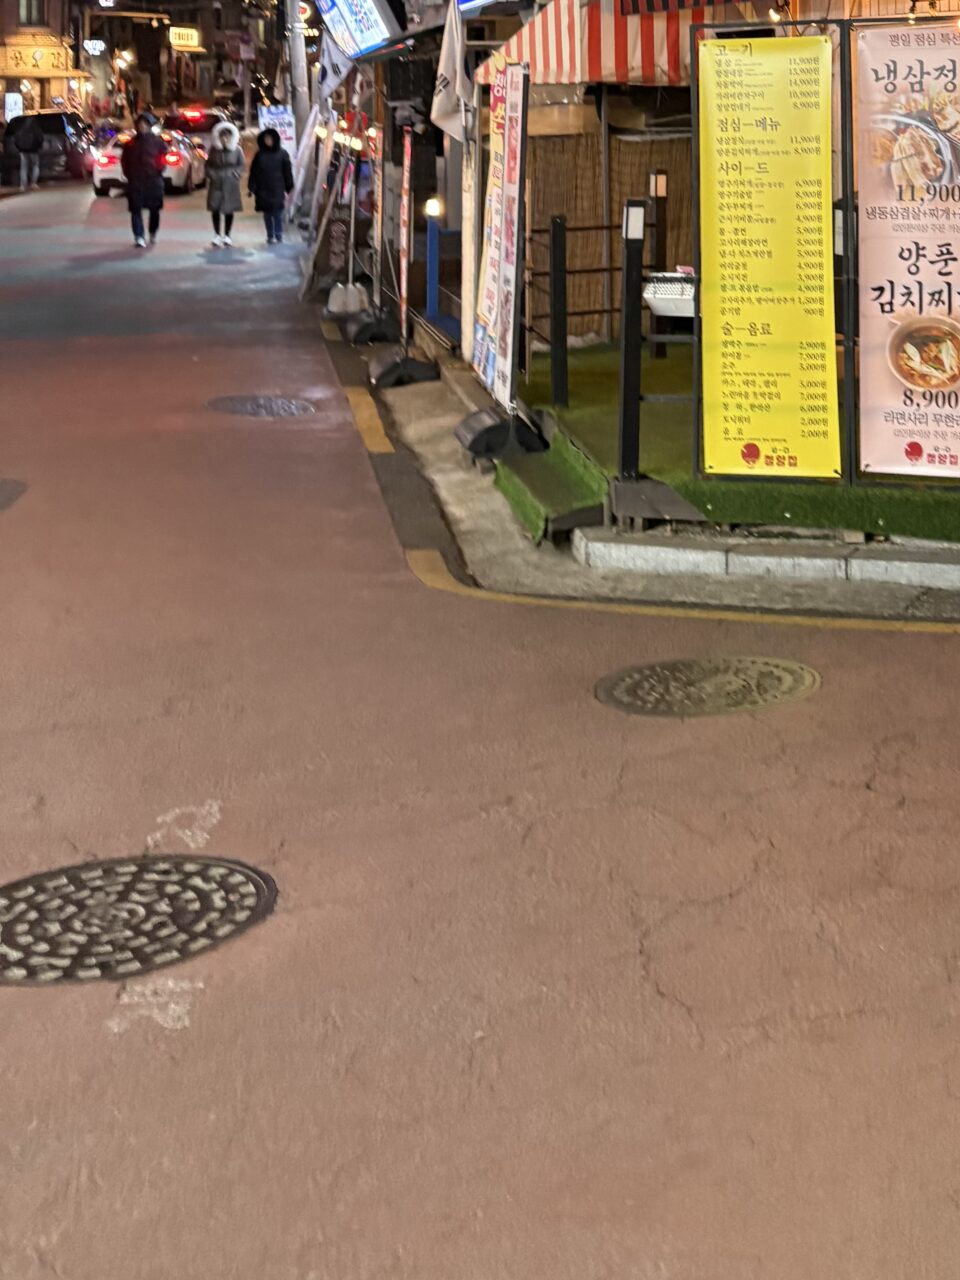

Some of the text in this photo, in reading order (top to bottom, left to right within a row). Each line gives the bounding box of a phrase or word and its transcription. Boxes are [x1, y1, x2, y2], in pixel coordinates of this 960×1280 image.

[889, 33, 911, 47] 평일
[914, 33, 936, 47] 점심
[898, 240, 958, 276] 양푼
[902, 388, 959, 410] 8,900
